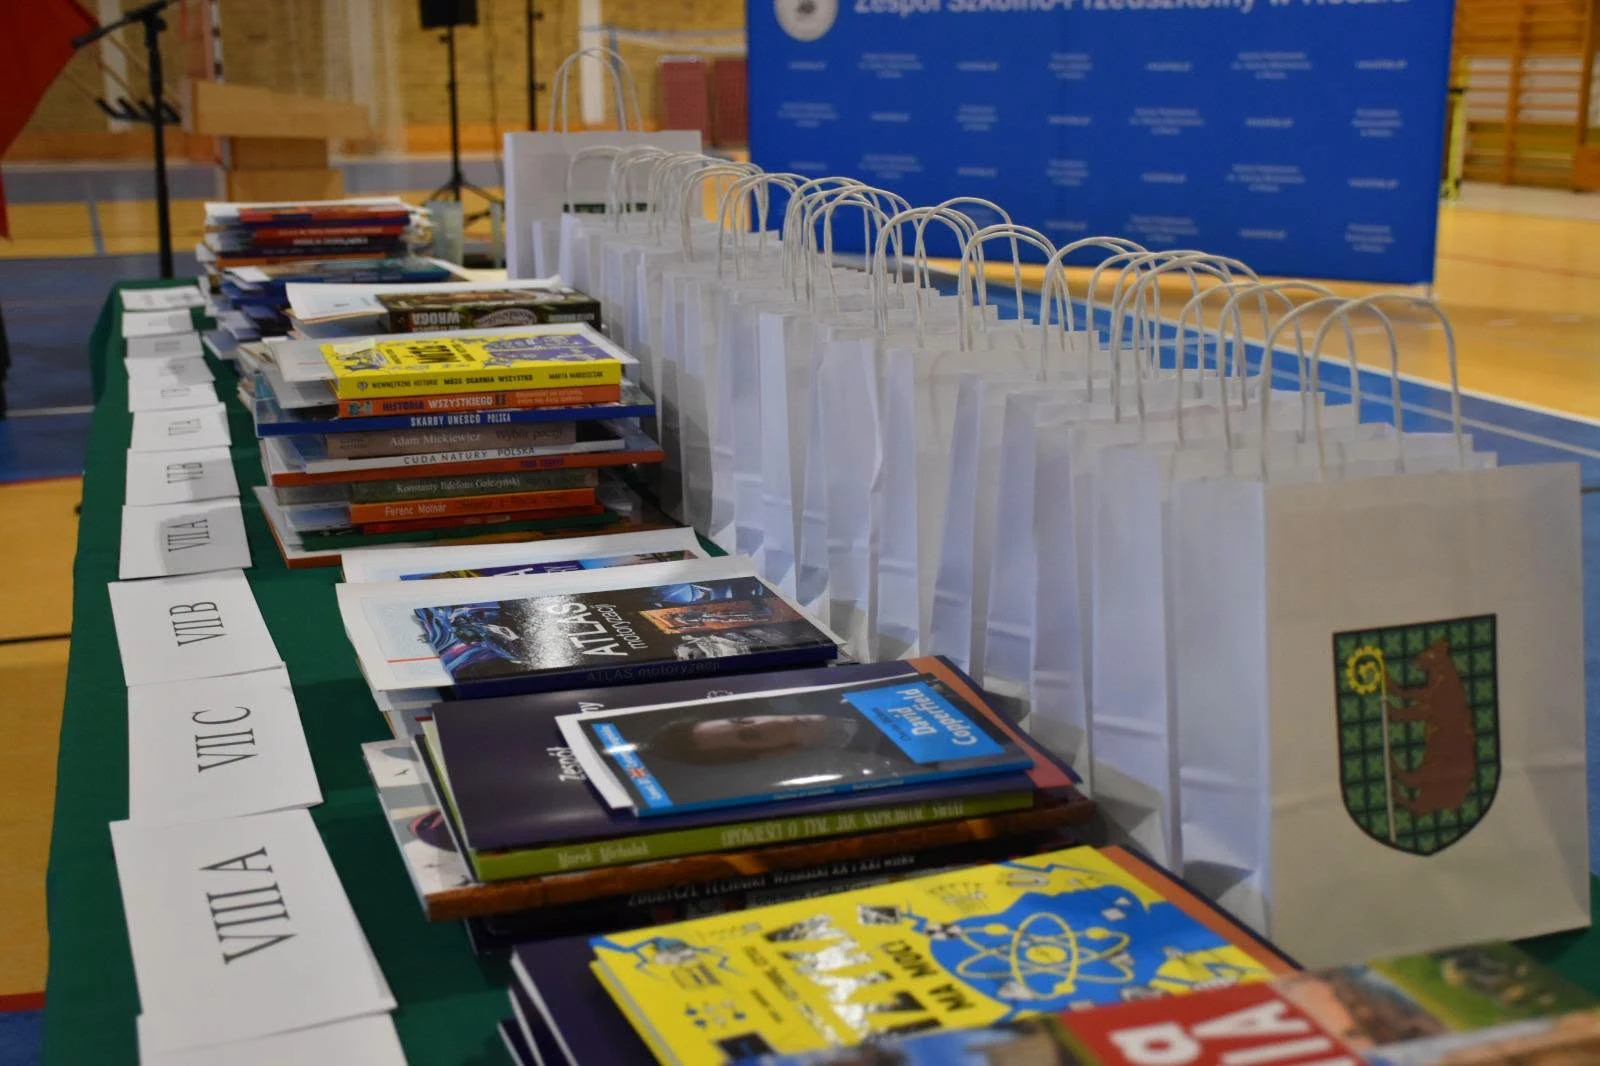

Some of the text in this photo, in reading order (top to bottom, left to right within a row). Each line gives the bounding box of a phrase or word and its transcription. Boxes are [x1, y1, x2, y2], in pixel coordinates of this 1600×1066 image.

[428, 396, 493, 409] WSZYSTKIEGO
[410, 412, 512, 427] SKARBY UNESCO POLSKA
[391, 436, 420, 447] Adam
[424, 431, 481, 447] Mickiewicz
[403, 446, 536, 465] CUDA NATURY POLSKA
[384, 504, 414, 516] Ferenc
[169, 601, 228, 647] VIIB
[548, 602, 628, 656] ATLAS
[591, 602, 649, 650] motoryzacji
[586, 668, 633, 683] ATLAS
[887, 705, 938, 736] David
[896, 687, 978, 746] Copperfield
[191, 706, 259, 773] VIIC
[199, 846, 297, 965] VIIIA
[929, 983, 976, 1012] MA
